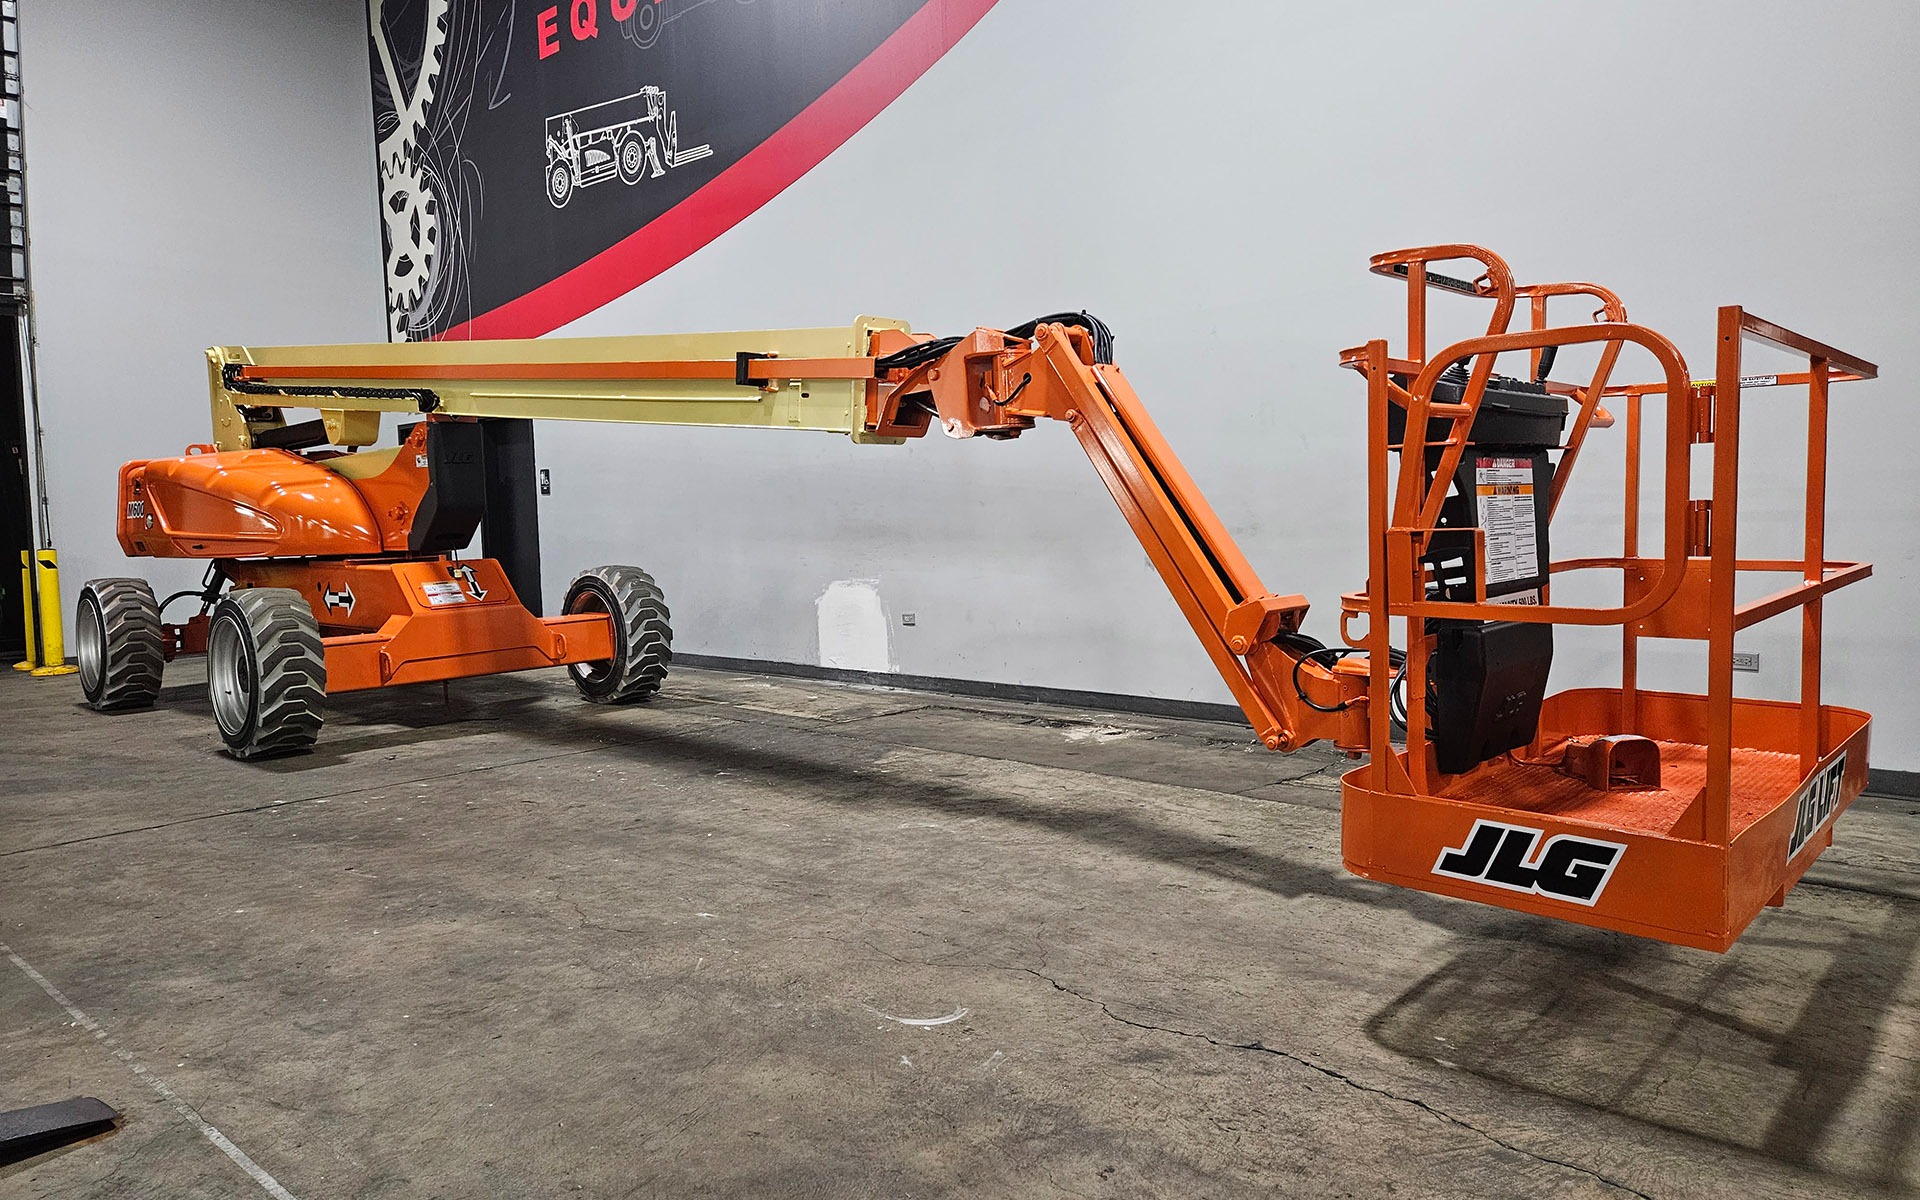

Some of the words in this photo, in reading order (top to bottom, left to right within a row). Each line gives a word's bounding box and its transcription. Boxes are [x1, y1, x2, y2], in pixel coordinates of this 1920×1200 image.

[1496, 457, 1516, 468] DANGER
[1496, 484, 1520, 495] WARNING
[127, 501, 145, 518] M600
[1786, 779, 1818, 862] JLG
[1814, 751, 1847, 830] LIFT
[1433, 820, 1627, 906] JLG
